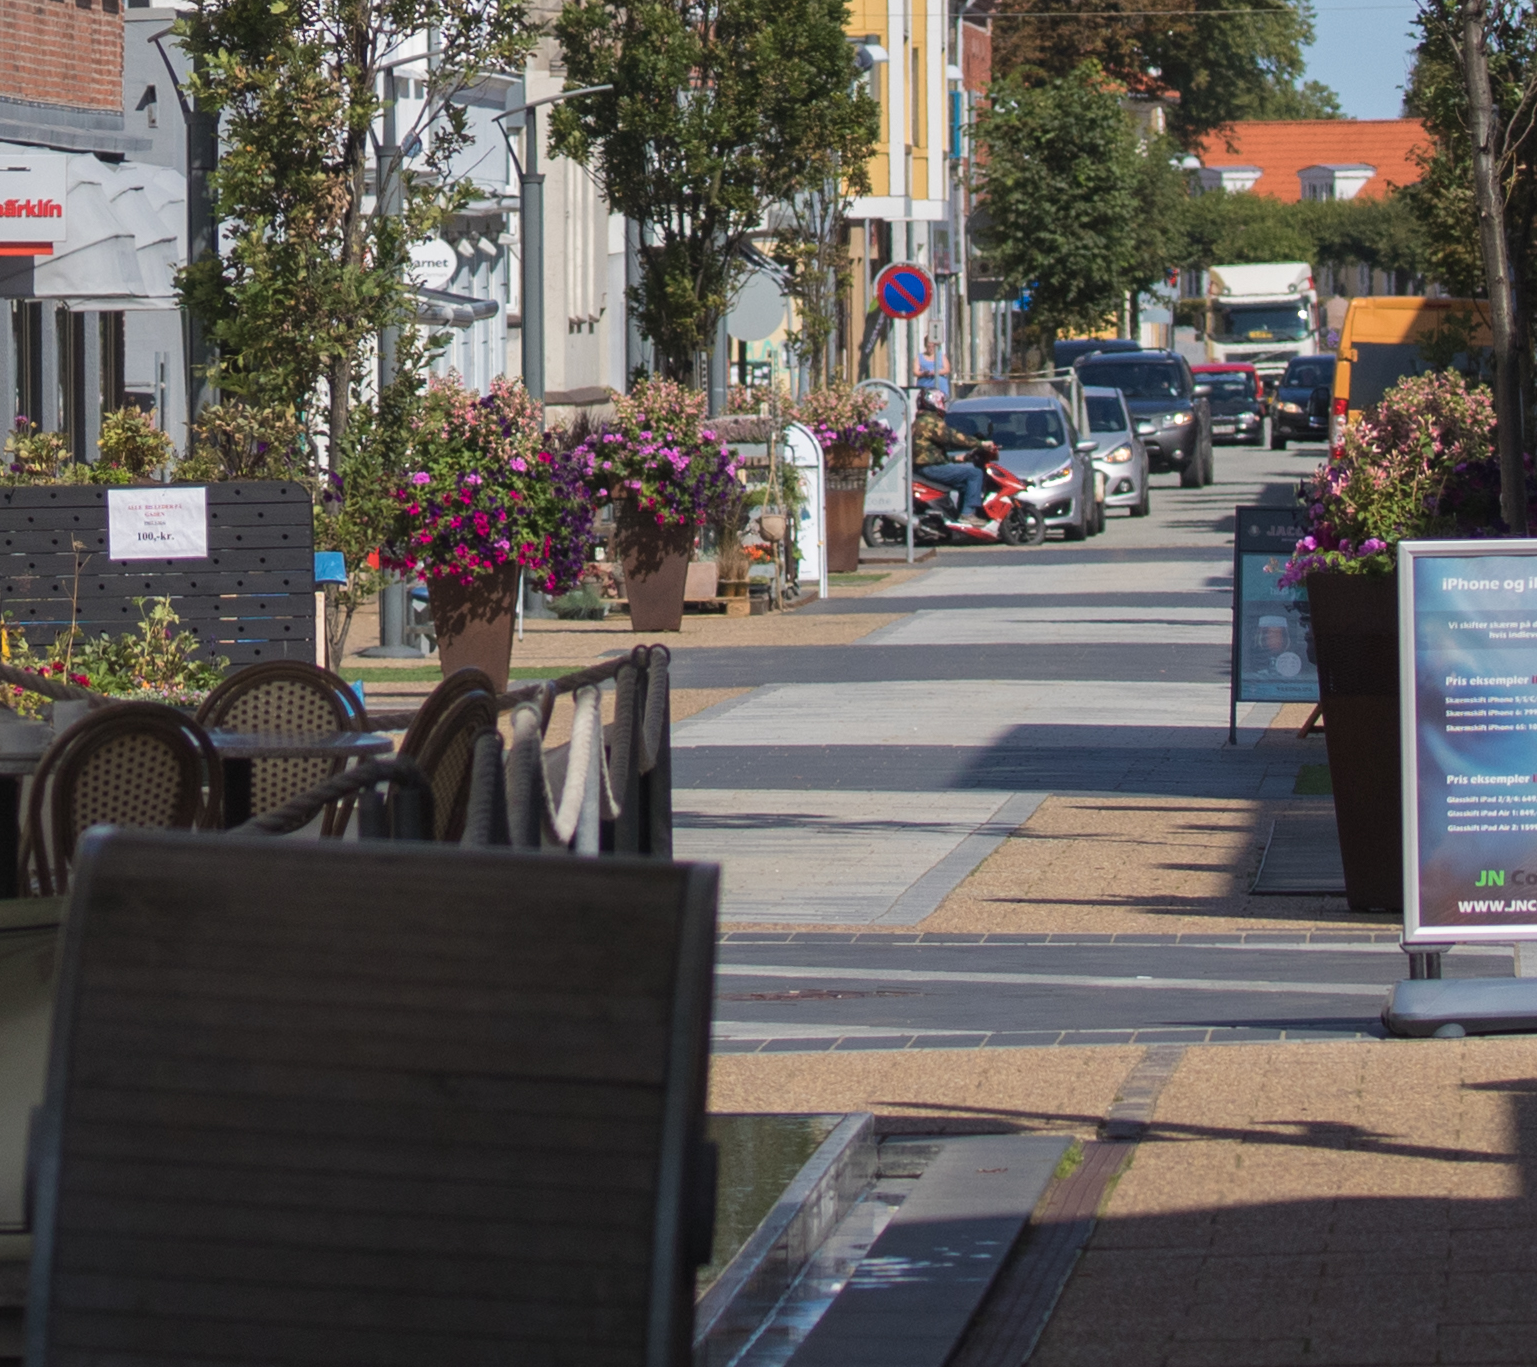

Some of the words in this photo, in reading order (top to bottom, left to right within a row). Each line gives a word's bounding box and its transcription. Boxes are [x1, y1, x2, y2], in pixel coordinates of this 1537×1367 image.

[414, 258, 449, 268] arnet
[137, 531, 175, 542] 100,-kr.
[1442, 577, 1499, 591] iPhone
[1504, 580, 1525, 593] og
[1445, 676, 1467, 686] Pris
[1470, 675, 1529, 688] eksempler
[1446, 775, 1469, 785] Pris
[1470, 774, 1530, 786] eksempler
[1475, 870, 1505, 887] JN
